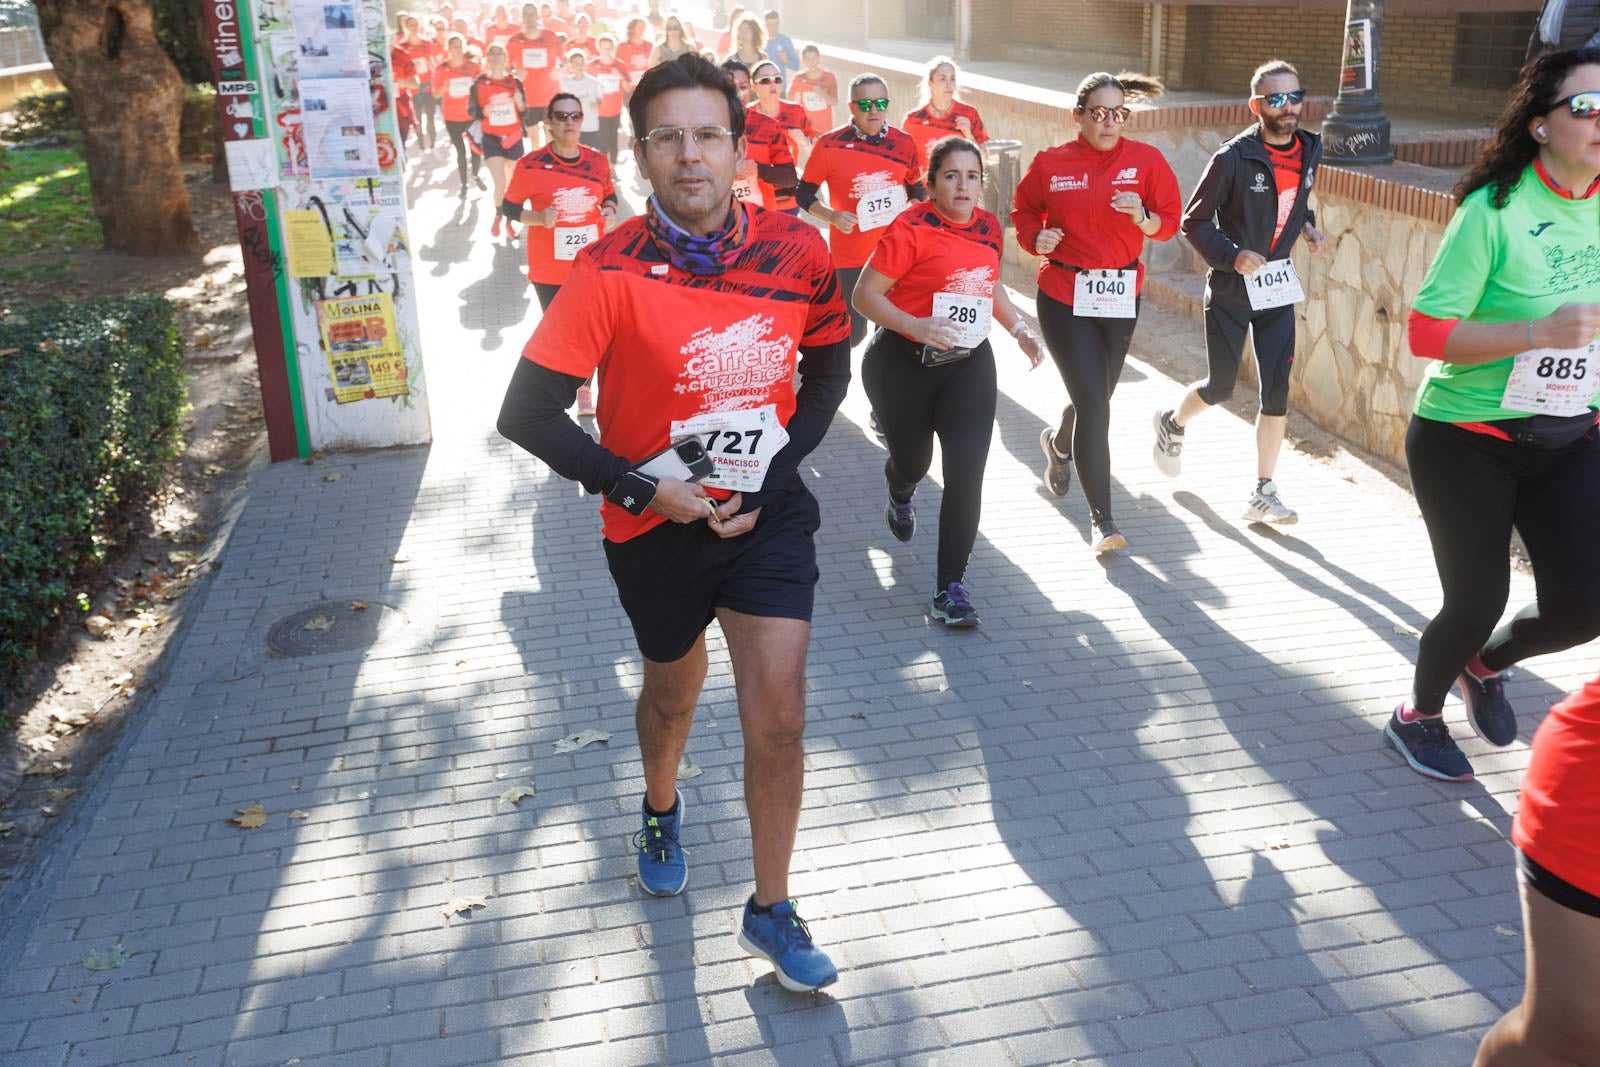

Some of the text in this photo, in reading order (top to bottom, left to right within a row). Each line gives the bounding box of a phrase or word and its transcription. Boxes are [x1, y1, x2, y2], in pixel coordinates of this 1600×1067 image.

[220, 83, 256, 94] MPS
[867, 196, 892, 212] 375
[565, 233, 588, 245] 226
[1254, 270, 1290, 288] 1041
[1086, 280, 1125, 295] 1040
[327, 303, 381, 317] MOLINA
[948, 305, 977, 324] 289
[686, 344, 786, 375] carrera
[370, 361, 391, 374] 149
[1537, 356, 1587, 380] 885
[688, 365, 784, 392] cruzroja.es
[1545, 383, 1578, 392] MONKEYS
[703, 429, 763, 455] 727
[712, 457, 760, 468] FRANCISCO
